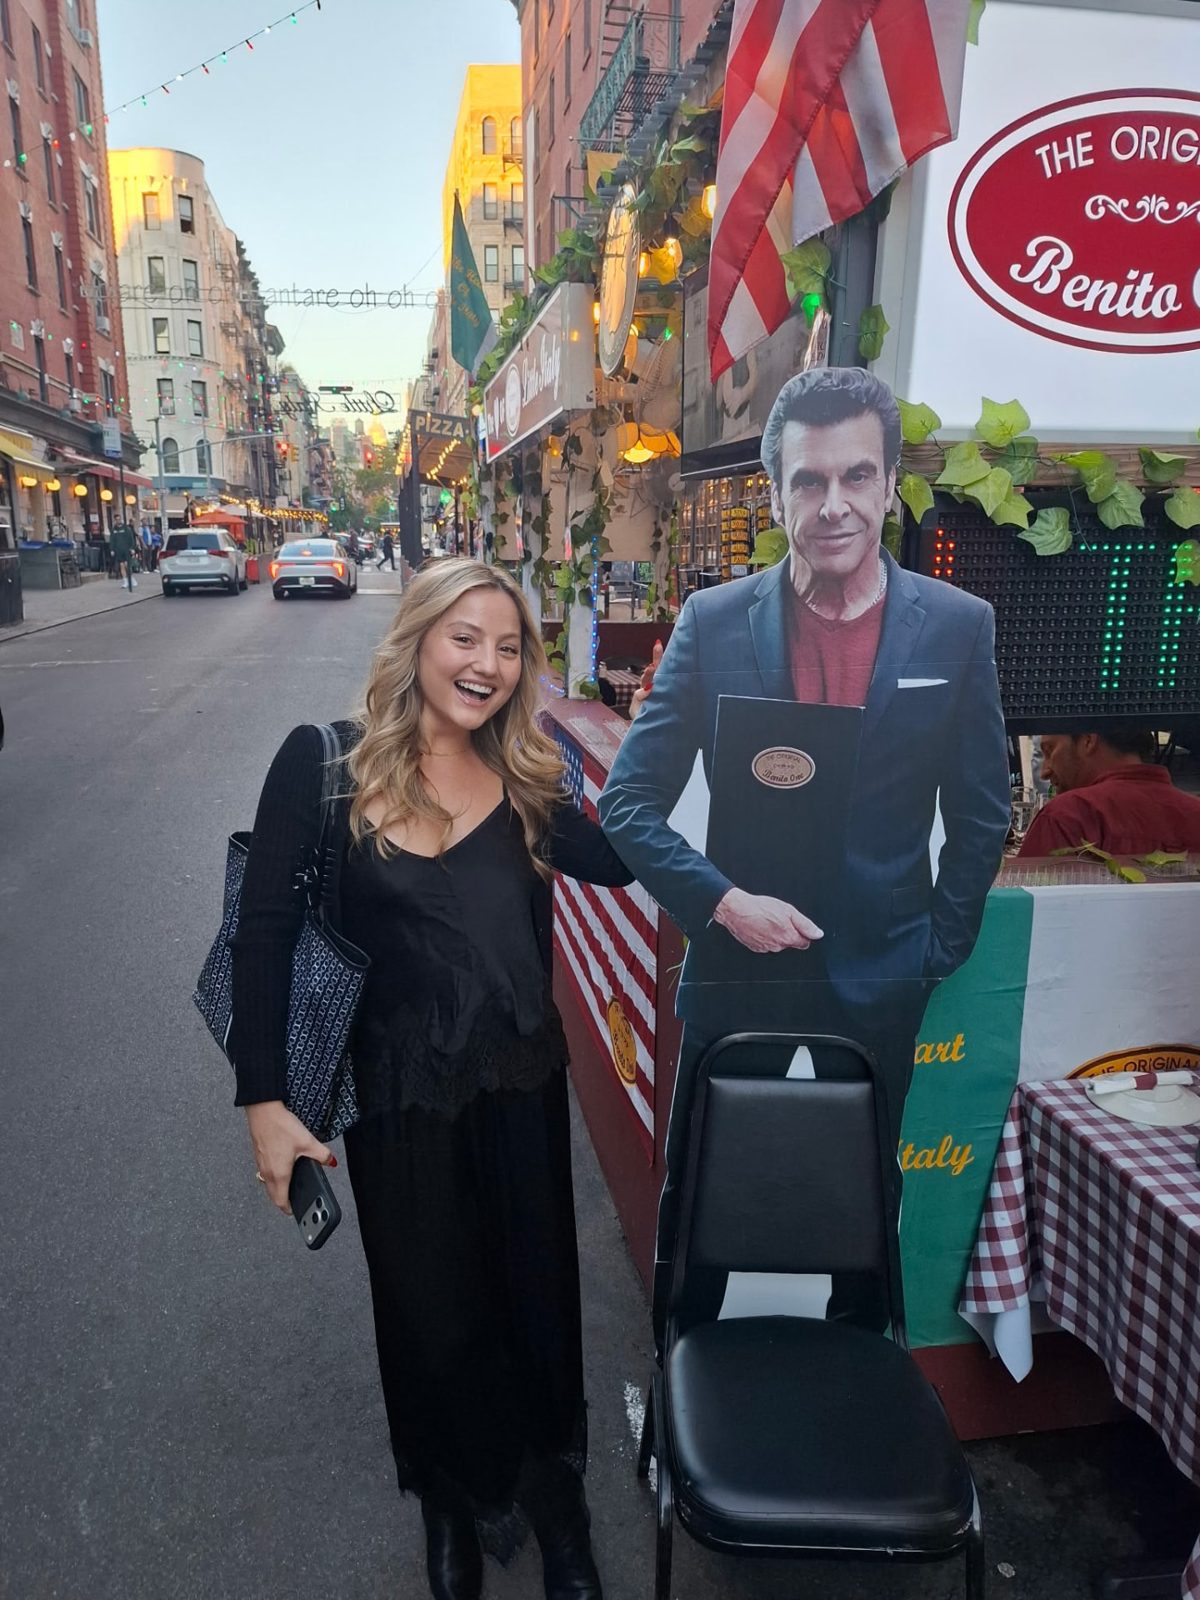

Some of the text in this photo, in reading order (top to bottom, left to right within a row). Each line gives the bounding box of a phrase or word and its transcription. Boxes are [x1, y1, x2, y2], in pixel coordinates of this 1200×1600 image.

[1035, 125, 1200, 179] THE ORIG
[1009, 235, 1182, 318] Benito
[350, 282, 377, 309] oh
[387, 283, 415, 310] oh
[415, 415, 464, 438] PIZZA
[914, 1033, 966, 1065] art
[1123, 1056, 1200, 1073] ORIGINA
[899, 1135, 975, 1176] taly
